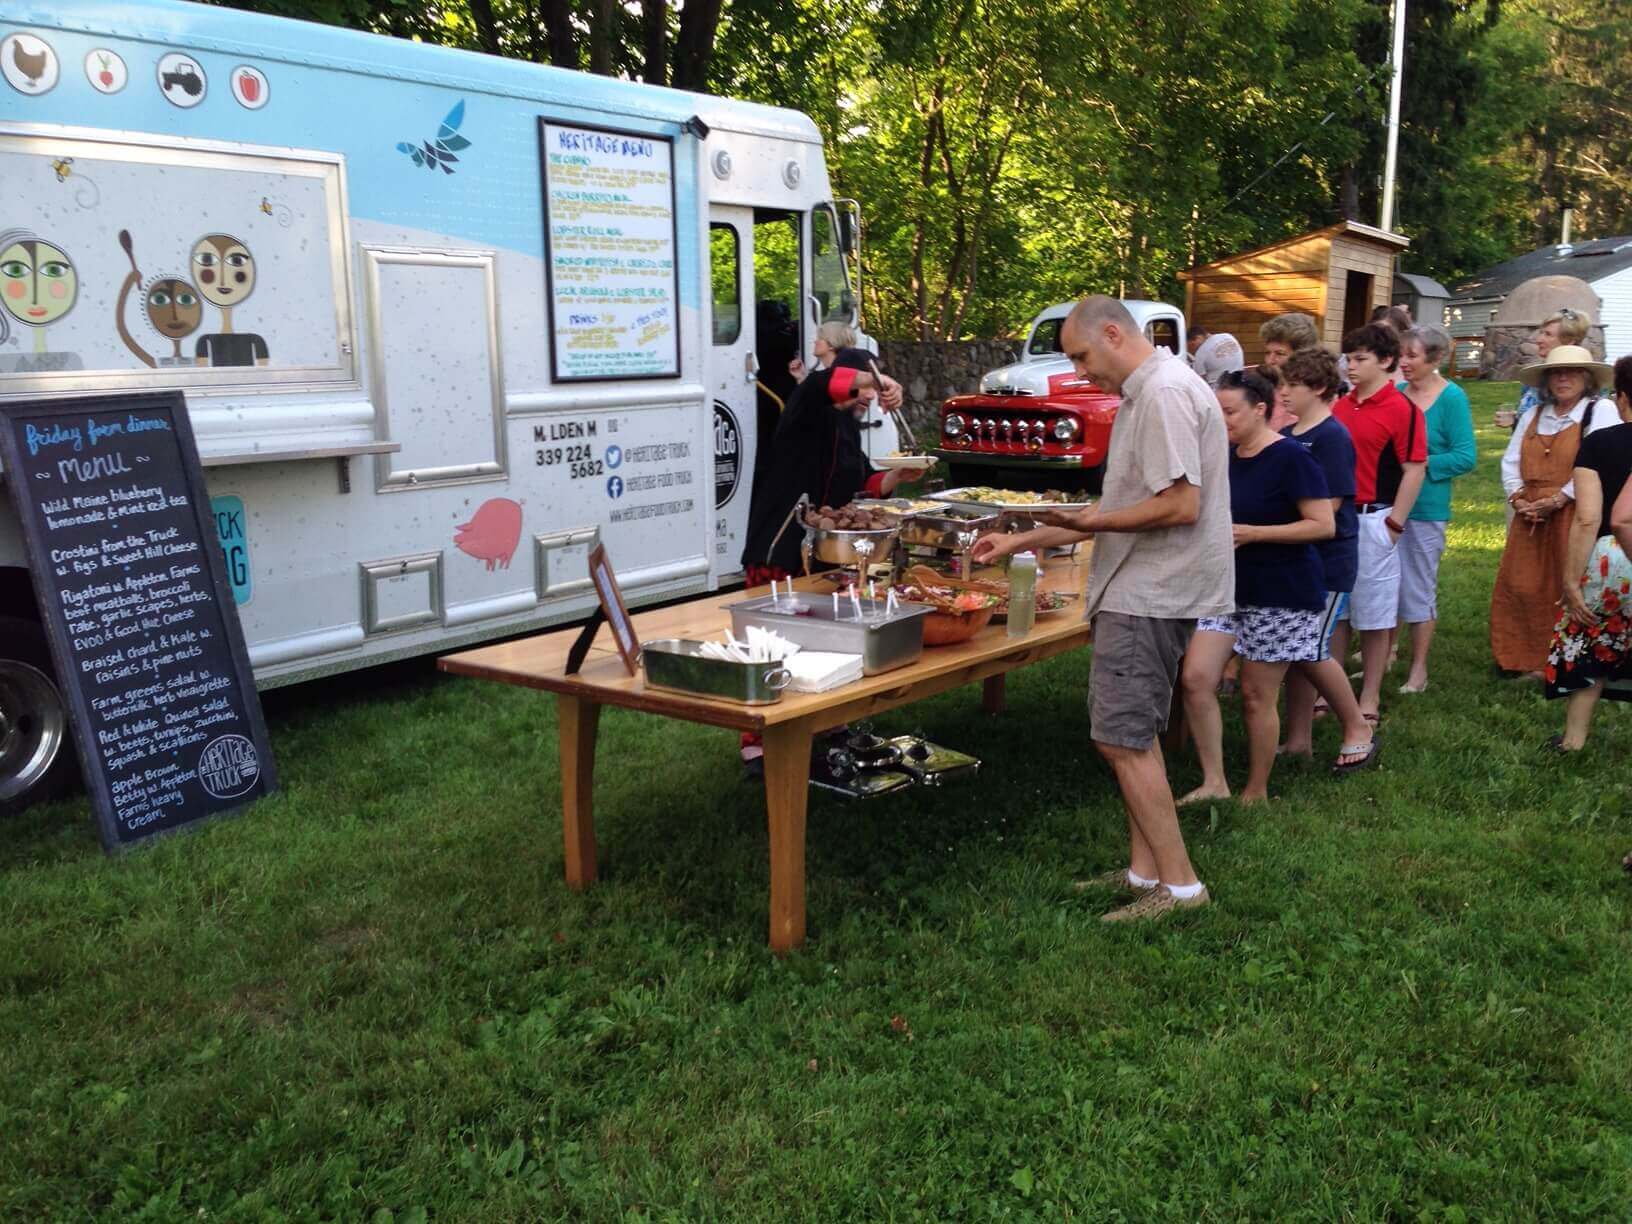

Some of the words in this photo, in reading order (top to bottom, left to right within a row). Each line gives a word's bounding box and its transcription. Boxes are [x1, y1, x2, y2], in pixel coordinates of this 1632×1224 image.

[536, 448, 562, 466] 339
[566, 444, 591, 462] 224
[571, 460, 603, 479] 5682
[658, 473, 673, 488] FOOD
[42, 498, 70, 514] Wild
[73, 496, 109, 508] Maine
[110, 485, 162, 503] blueberry
[47, 510, 106, 530] lemonade
[108, 507, 117, 519] &
[169, 495, 188, 506] tea
[51, 544, 99, 562] Crostini
[101, 539, 127, 553] from
[127, 536, 146, 547] the
[145, 527, 179, 542] Truck
[102, 555, 112, 567] &
[61, 582, 112, 606] Rigatoni
[125, 572, 168, 591] Appleton
[169, 564, 201, 580] Farms
[64, 604, 91, 620] beef
[149, 581, 190, 600] broccoli
[105, 630, 114, 641] &
[81, 650, 125, 672] Braised
[160, 635, 169, 648] &
[142, 659, 152, 670] &
[152, 654, 175, 672] pine
[176, 645, 202, 659] nuts
[92, 696, 122, 710] Farm
[125, 683, 164, 704] greens
[166, 670, 197, 689] salad
[98, 728, 121, 744] Red
[202, 697, 230, 713] salad
[205, 766, 242, 792] TRUCK
[113, 788, 147, 807] Betty
[118, 802, 150, 821] Farms
[151, 790, 184, 806] heavy
